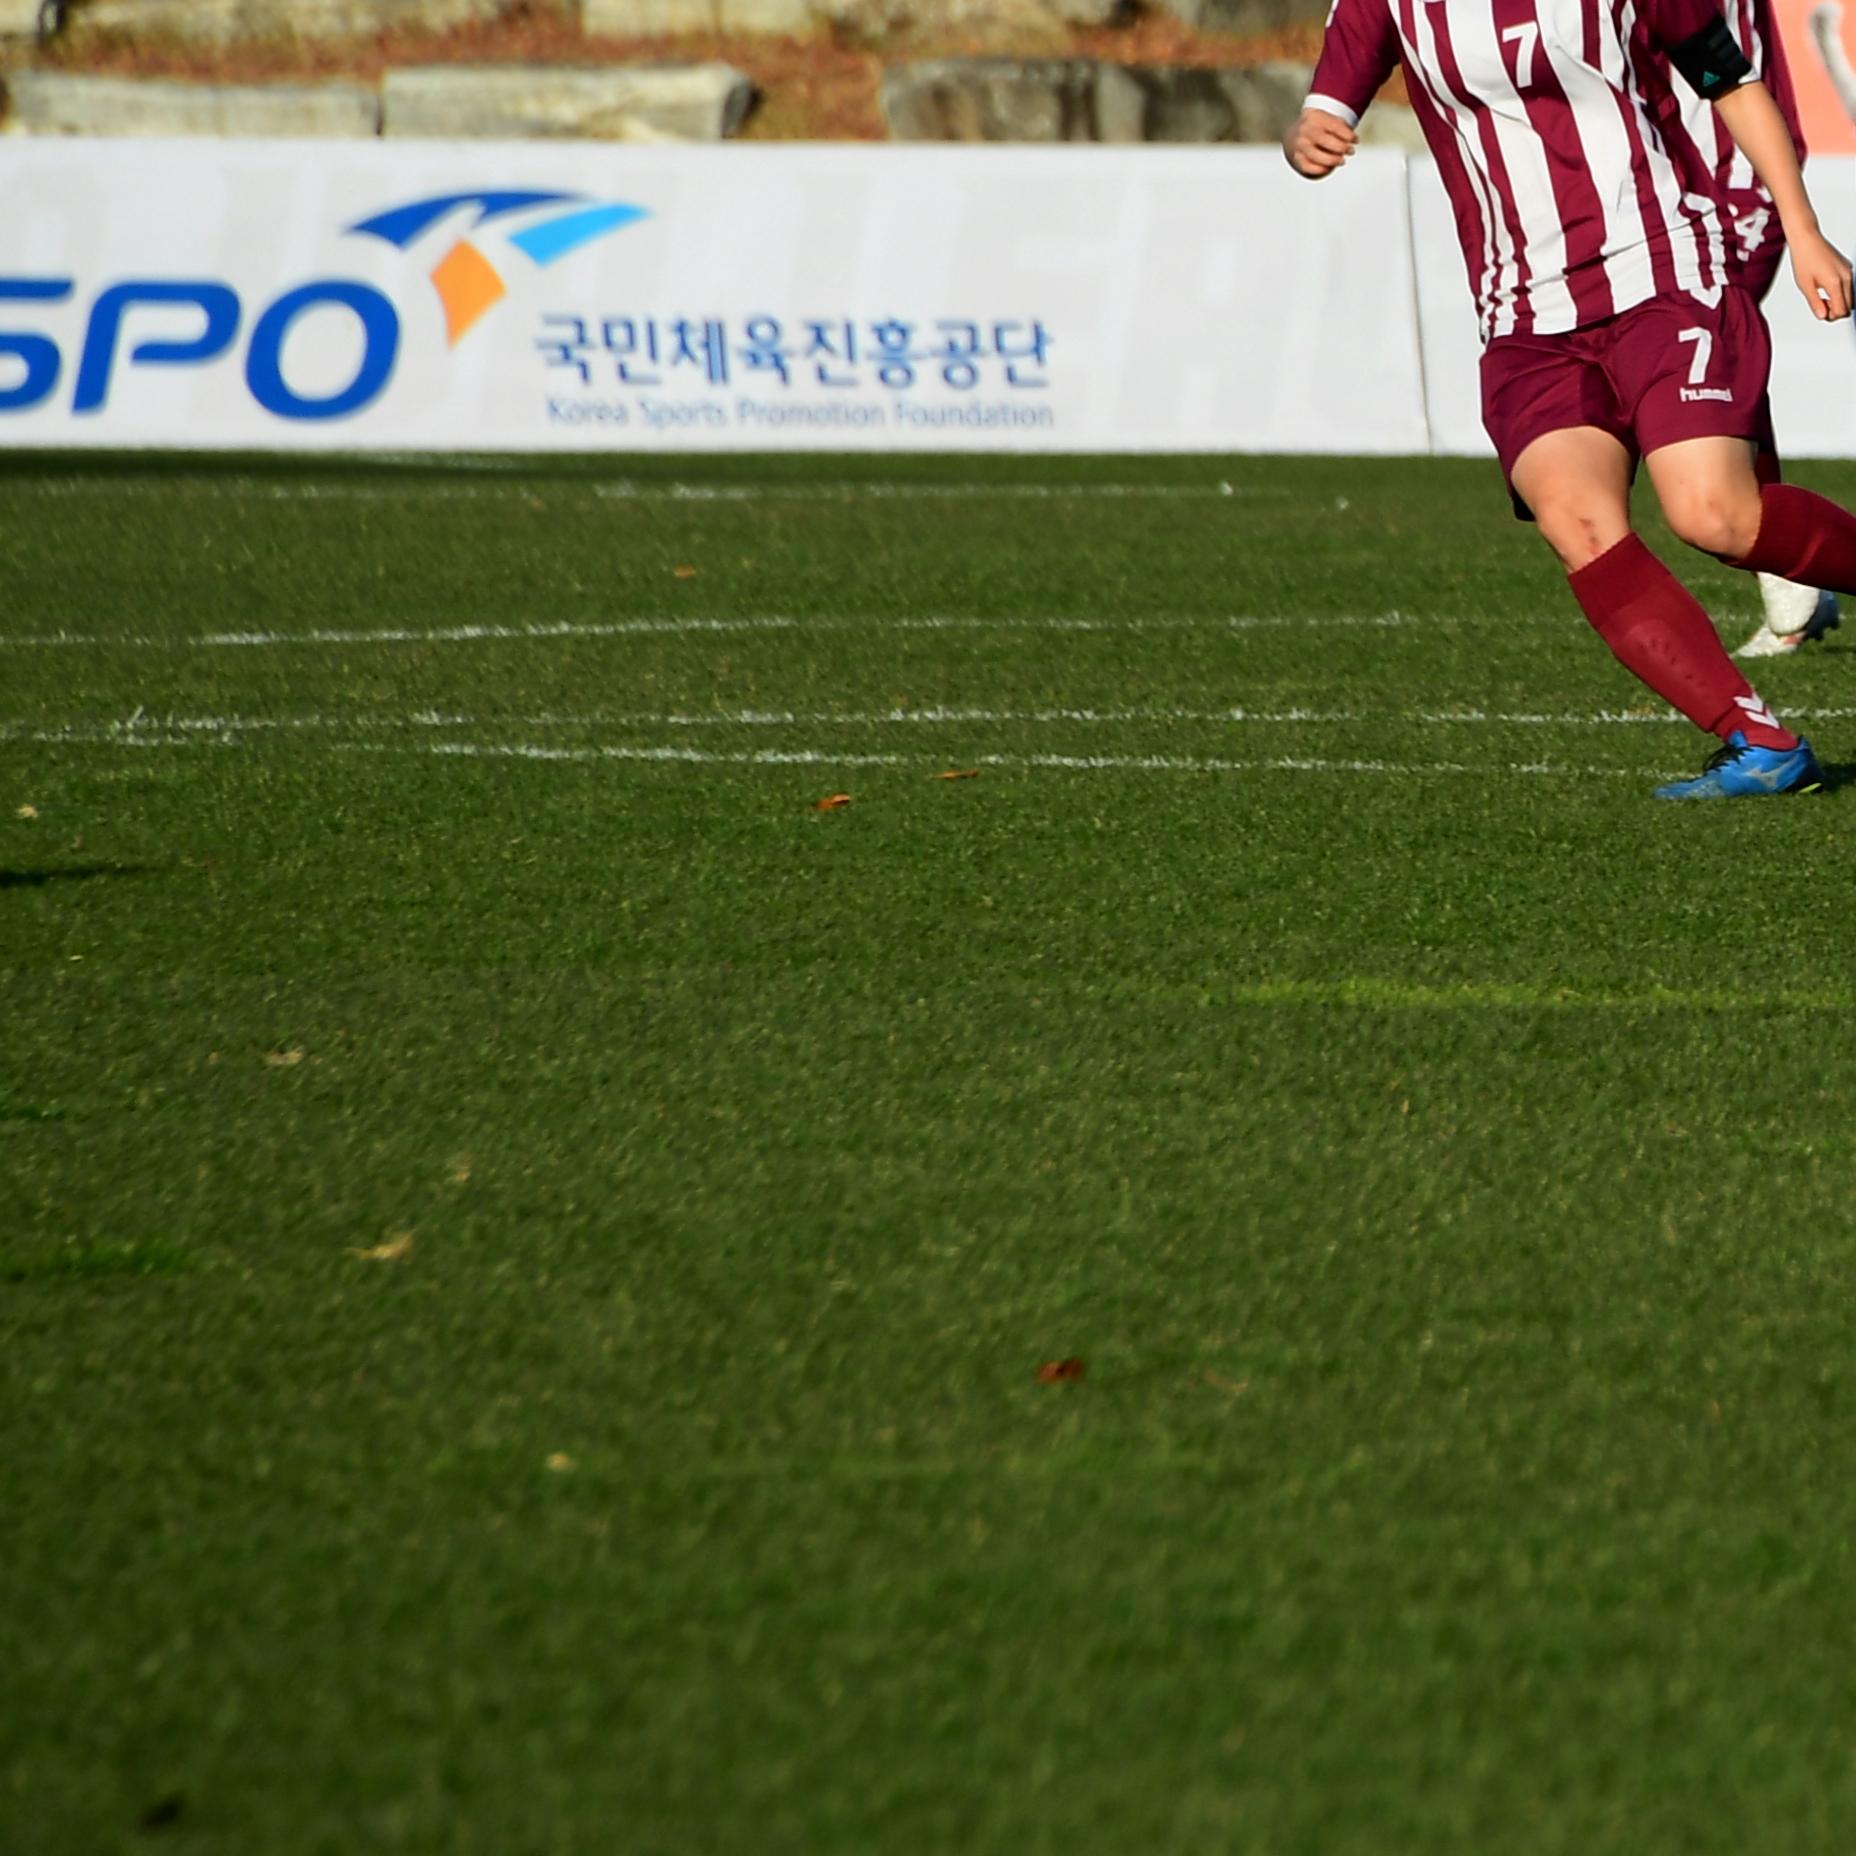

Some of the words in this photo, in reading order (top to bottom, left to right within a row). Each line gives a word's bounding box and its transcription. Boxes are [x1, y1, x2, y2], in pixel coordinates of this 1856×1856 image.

[1502, 20, 1539, 88] 7
[536, 313, 1054, 388] 국민체육진흥공단
[1678, 326, 1713, 385] 7
[548, 398, 628, 427] Korea
[640, 398, 728, 430] Sports
[738, 398, 885, 427] Promotion
[895, 398, 1054, 428] Foundation
